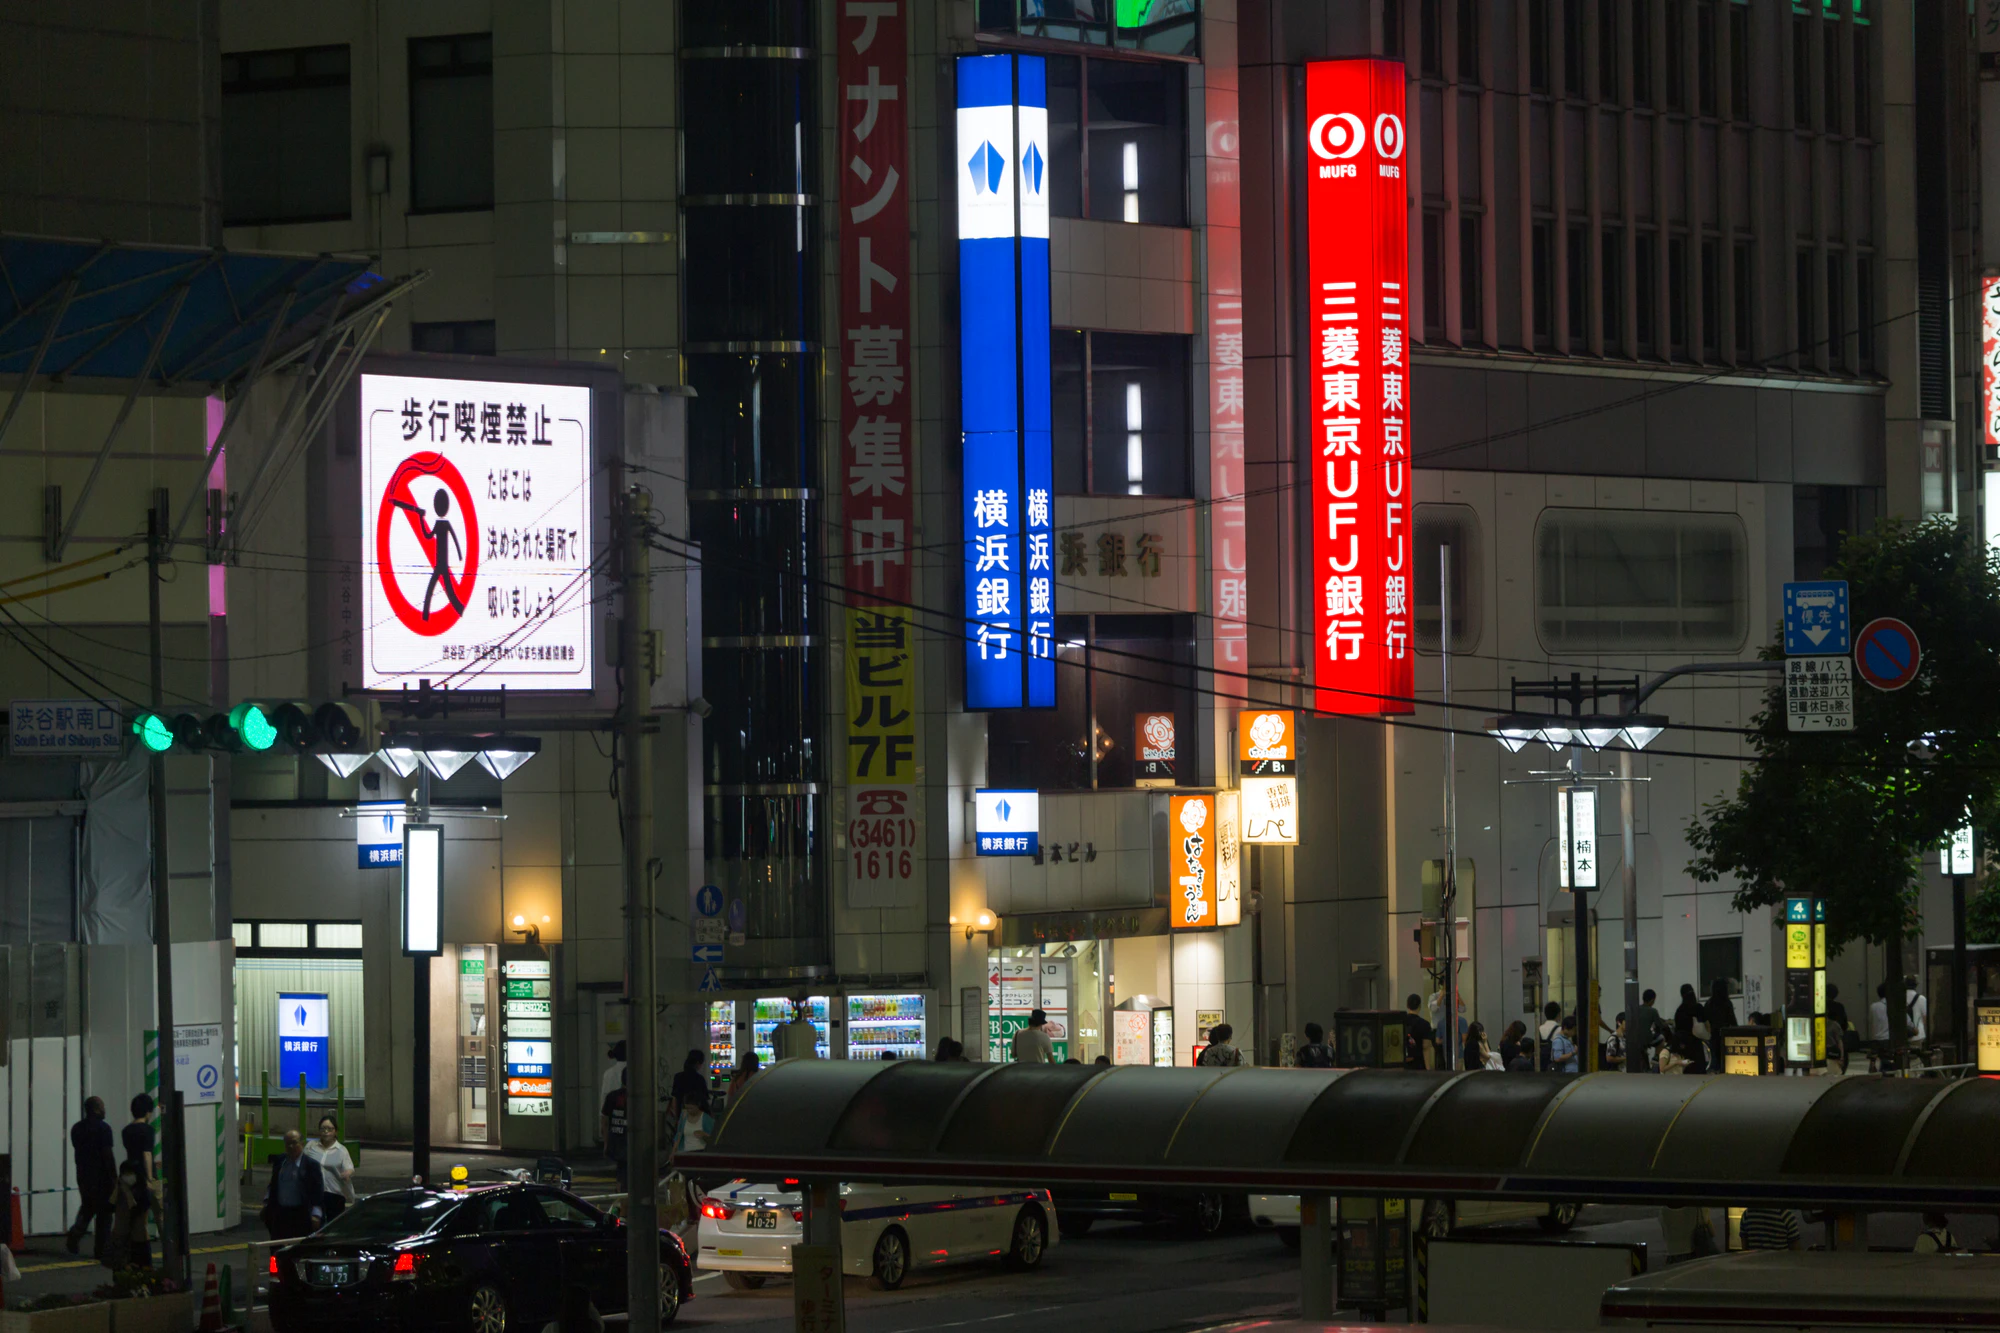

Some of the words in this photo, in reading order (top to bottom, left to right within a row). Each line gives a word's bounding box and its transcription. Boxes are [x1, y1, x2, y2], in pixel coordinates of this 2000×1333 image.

[1319, 164, 1357, 179] MUFG
[1379, 164, 1400, 179] MUFG
[846, 1, 905, 588] テナント募集中
[401, 396, 553, 446] 歩行喫煙禁止
[1322, 281, 1364, 661] 三菱東京UFJ銀行
[1381, 281, 1407, 661] 三菱東京UFJ銀行
[487, 469, 532, 502] たばこは
[487, 526, 578, 562] 決められた場所で
[974, 489, 1011, 660] 横浜銀行
[1028, 488, 1050, 659] 横浜銀行
[487, 585, 556, 619] 吸いましょう
[1801, 609, 1832, 624] 優先
[1790, 660, 1846, 673] 路線バス
[1788, 686, 1850, 698] 通勤送迎バス
[16, 708, 114, 731] 渋谷駅南口
[14, 734, 38, 747] South
[39, 734, 56, 747] Exit
[57, 734, 66, 746] of
[68, 734, 101, 748] Shibuya
[1272, 761, 1285, 772] B1
[849, 818, 915, 848] (3461)
[981, 837, 1028, 851] 横浜銀行
[1577, 840, 1592, 872] 楠本
[853, 850, 912, 880] 1616
[1793, 901, 1804, 913] 4
[1816, 901, 1822, 912] 4
[501, 964, 507, 974] 9
[502, 1004, 507, 1013] 7
[995, 998, 1051, 1006] メニコン谷
[284, 1041, 318, 1052] 横浜銀行
[1344, 1026, 1372, 1055] 16
[753, 1217, 775, 1228] 10-29
